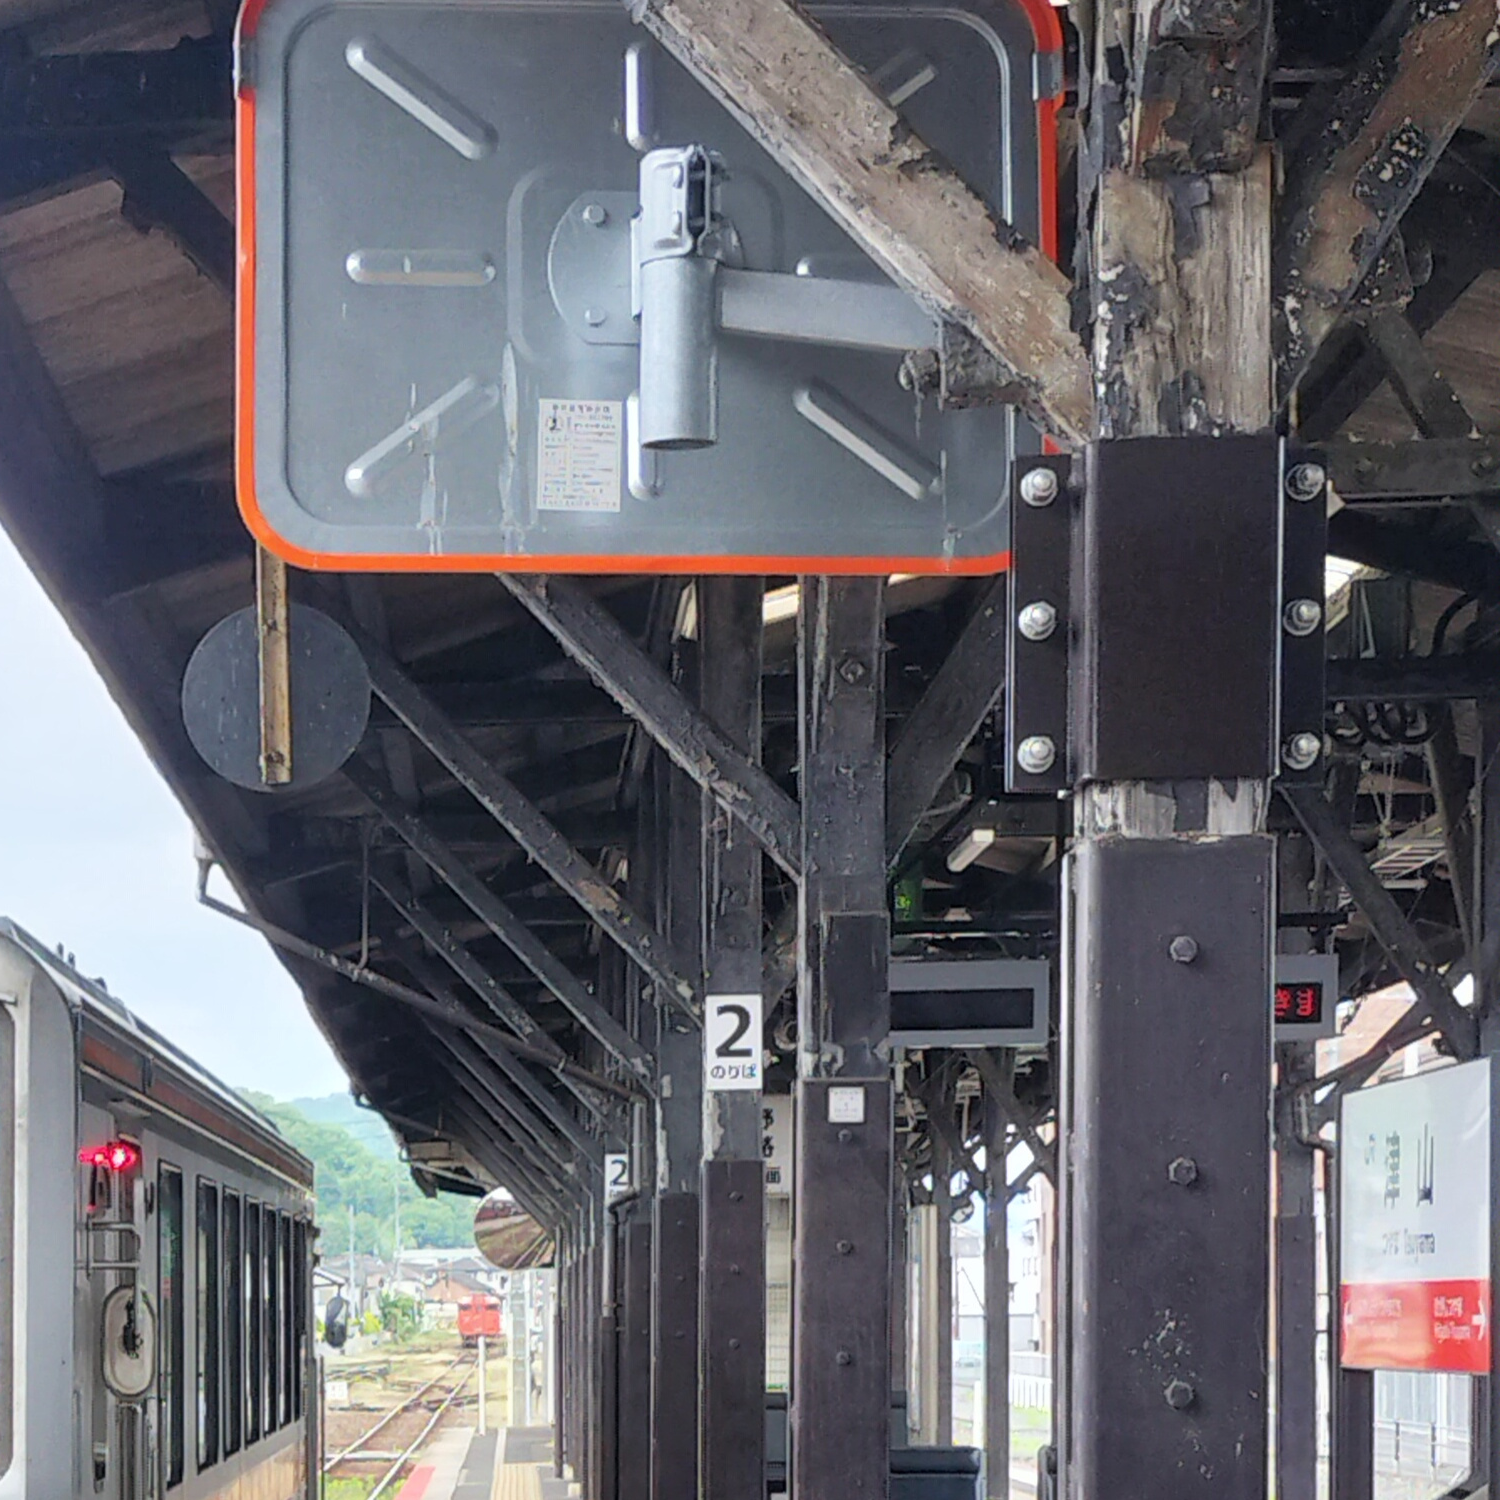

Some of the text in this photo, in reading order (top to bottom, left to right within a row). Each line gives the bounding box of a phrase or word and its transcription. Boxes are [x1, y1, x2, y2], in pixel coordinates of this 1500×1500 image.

[715, 1004, 753, 1058] 2
[710, 1063, 757, 1079] のりば
